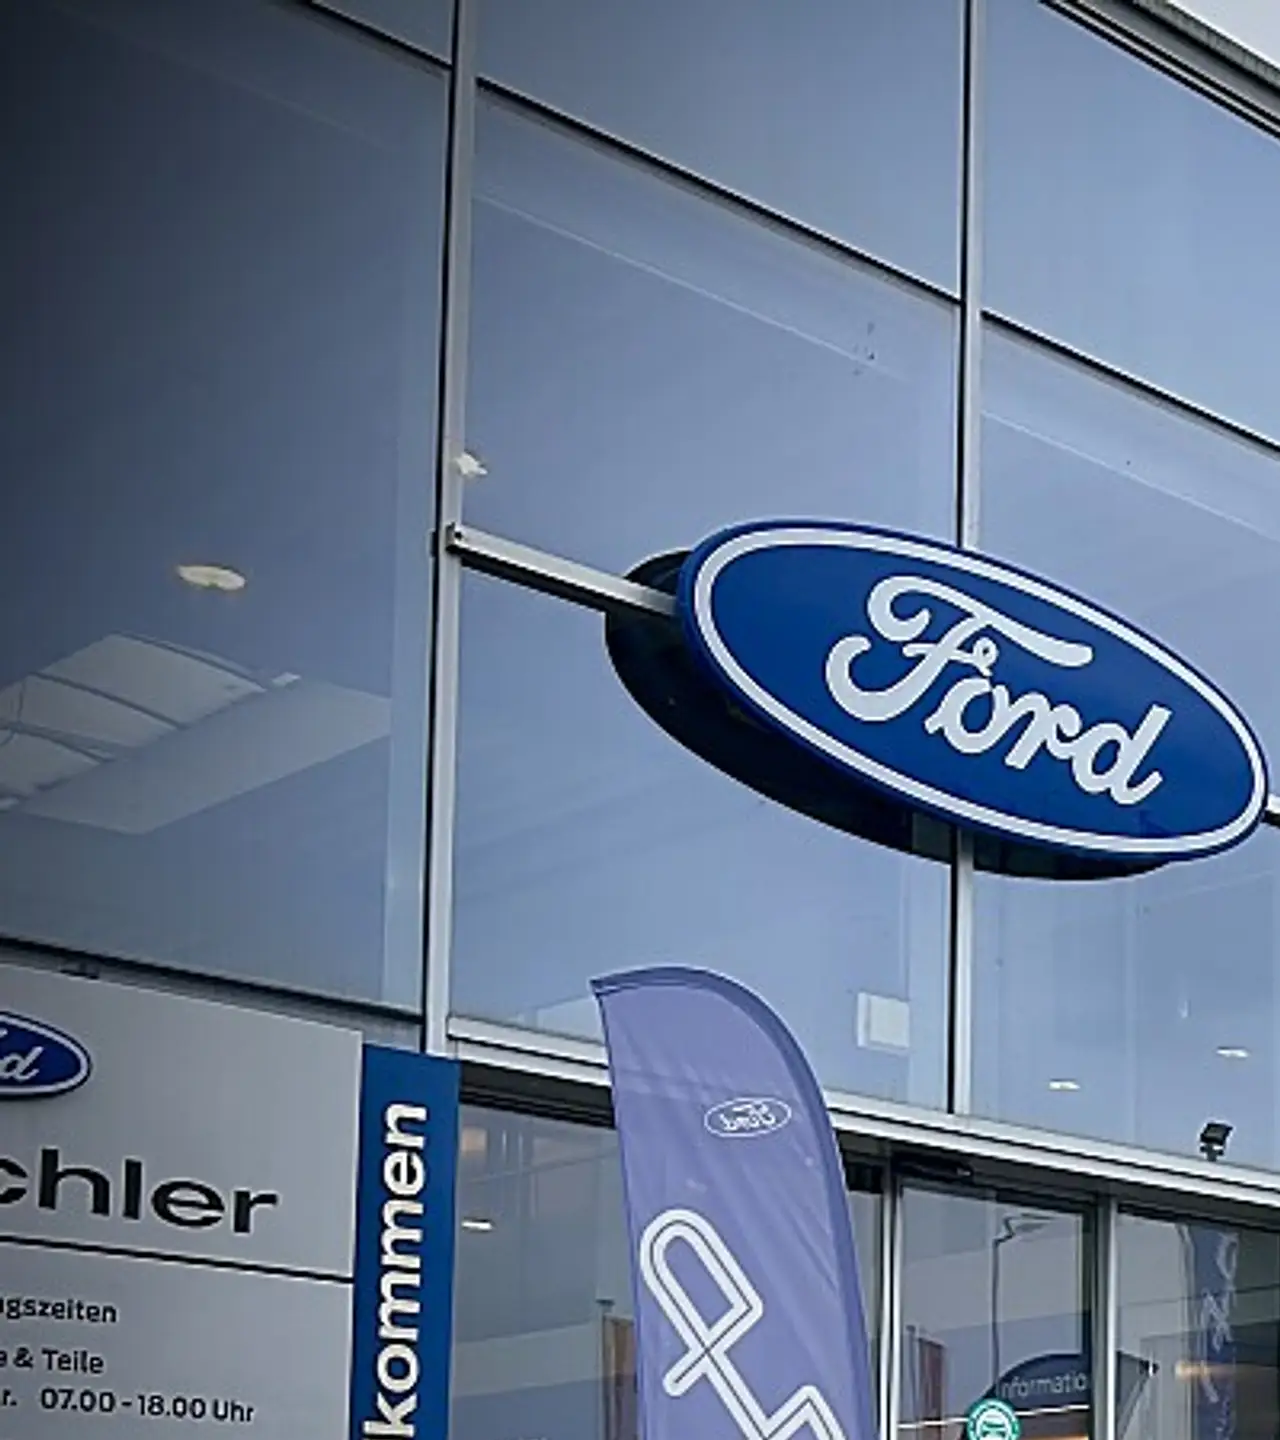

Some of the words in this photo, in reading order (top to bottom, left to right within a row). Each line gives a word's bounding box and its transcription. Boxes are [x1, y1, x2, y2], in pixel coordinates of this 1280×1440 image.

[825, 576, 1172, 804] Ford
[0, 1298, 117, 1323] gszeiten
[42, 1348, 104, 1374] Teile
[41, 1388, 116, 1413] 07.00
[138, 1394, 206, 1419] 18.00
[213, 1398, 254, 1422] Uhr
